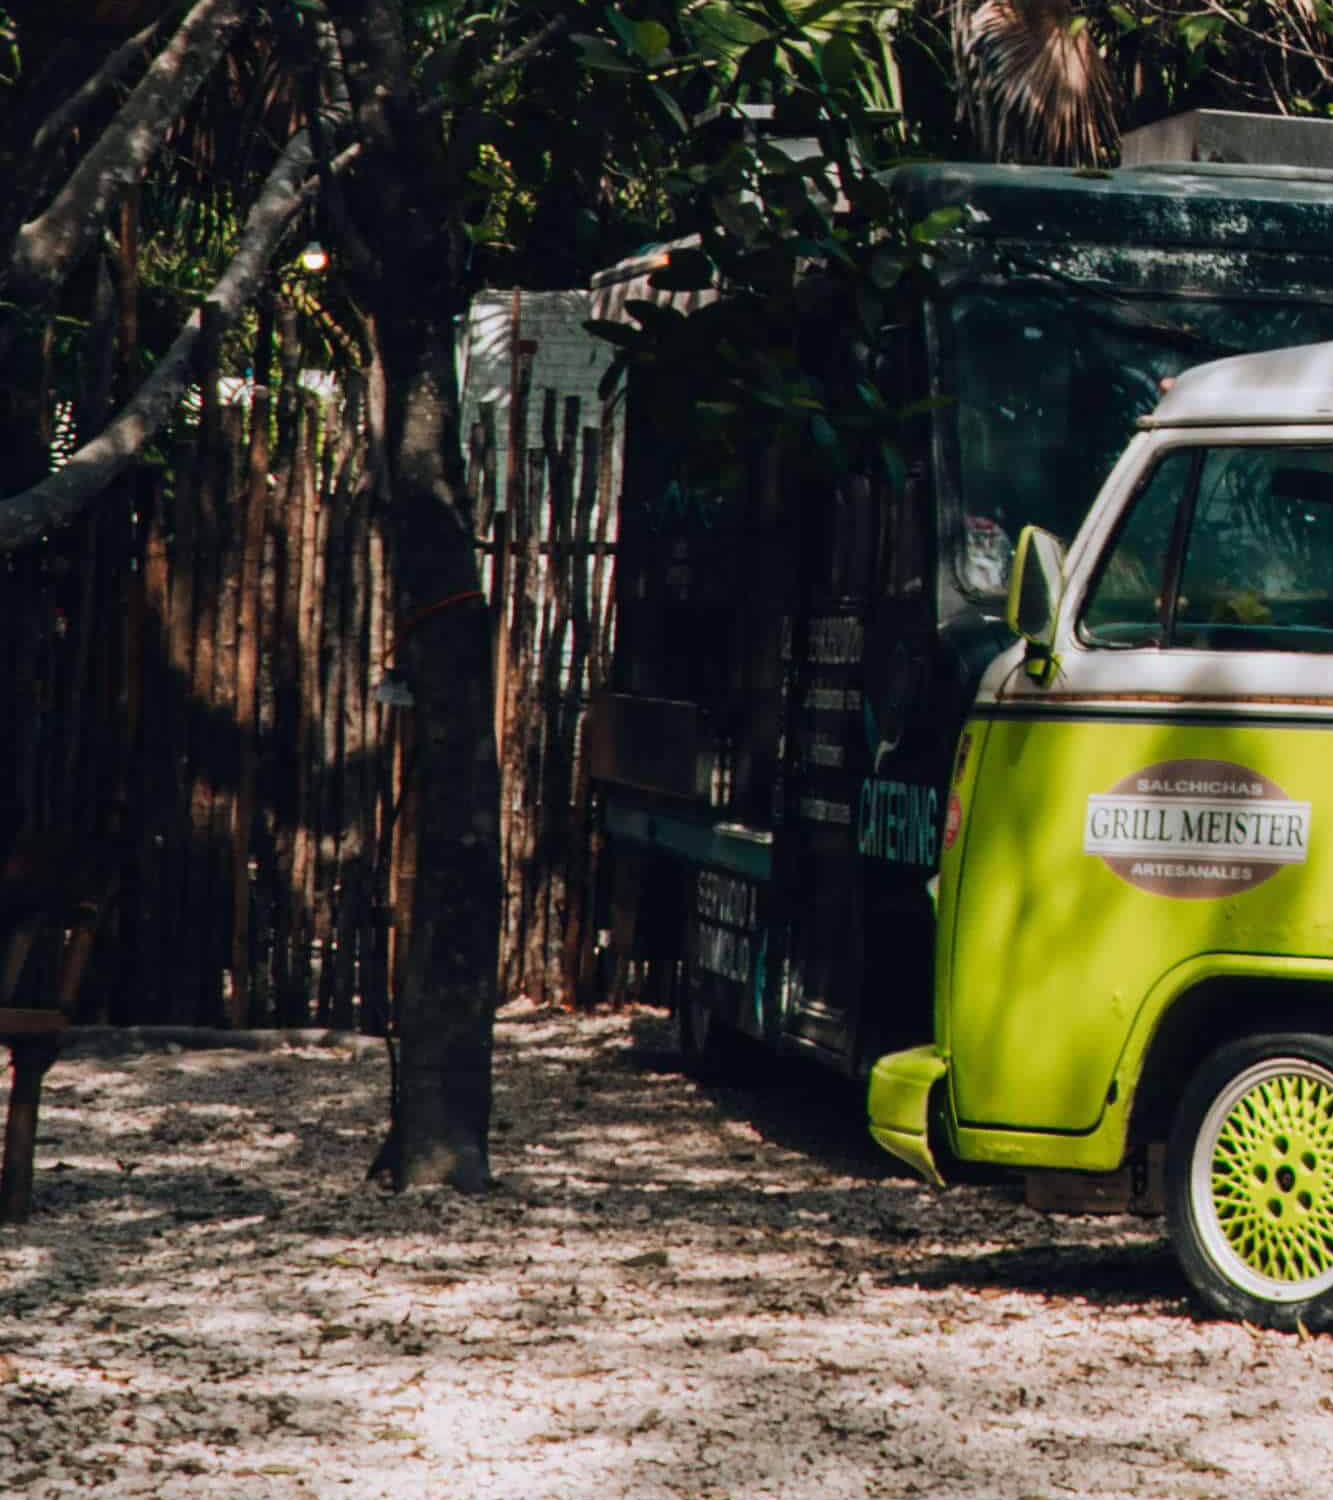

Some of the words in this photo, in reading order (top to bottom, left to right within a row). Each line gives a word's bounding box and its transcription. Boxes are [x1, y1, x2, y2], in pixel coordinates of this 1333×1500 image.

[1136, 778, 1263, 796] SALCHICHAS
[858, 778, 936, 866] CATERING
[1090, 807, 1172, 841] GRILL
[1180, 809, 1304, 848] MEISTER
[1130, 862, 1253, 880] ARTESANALES
